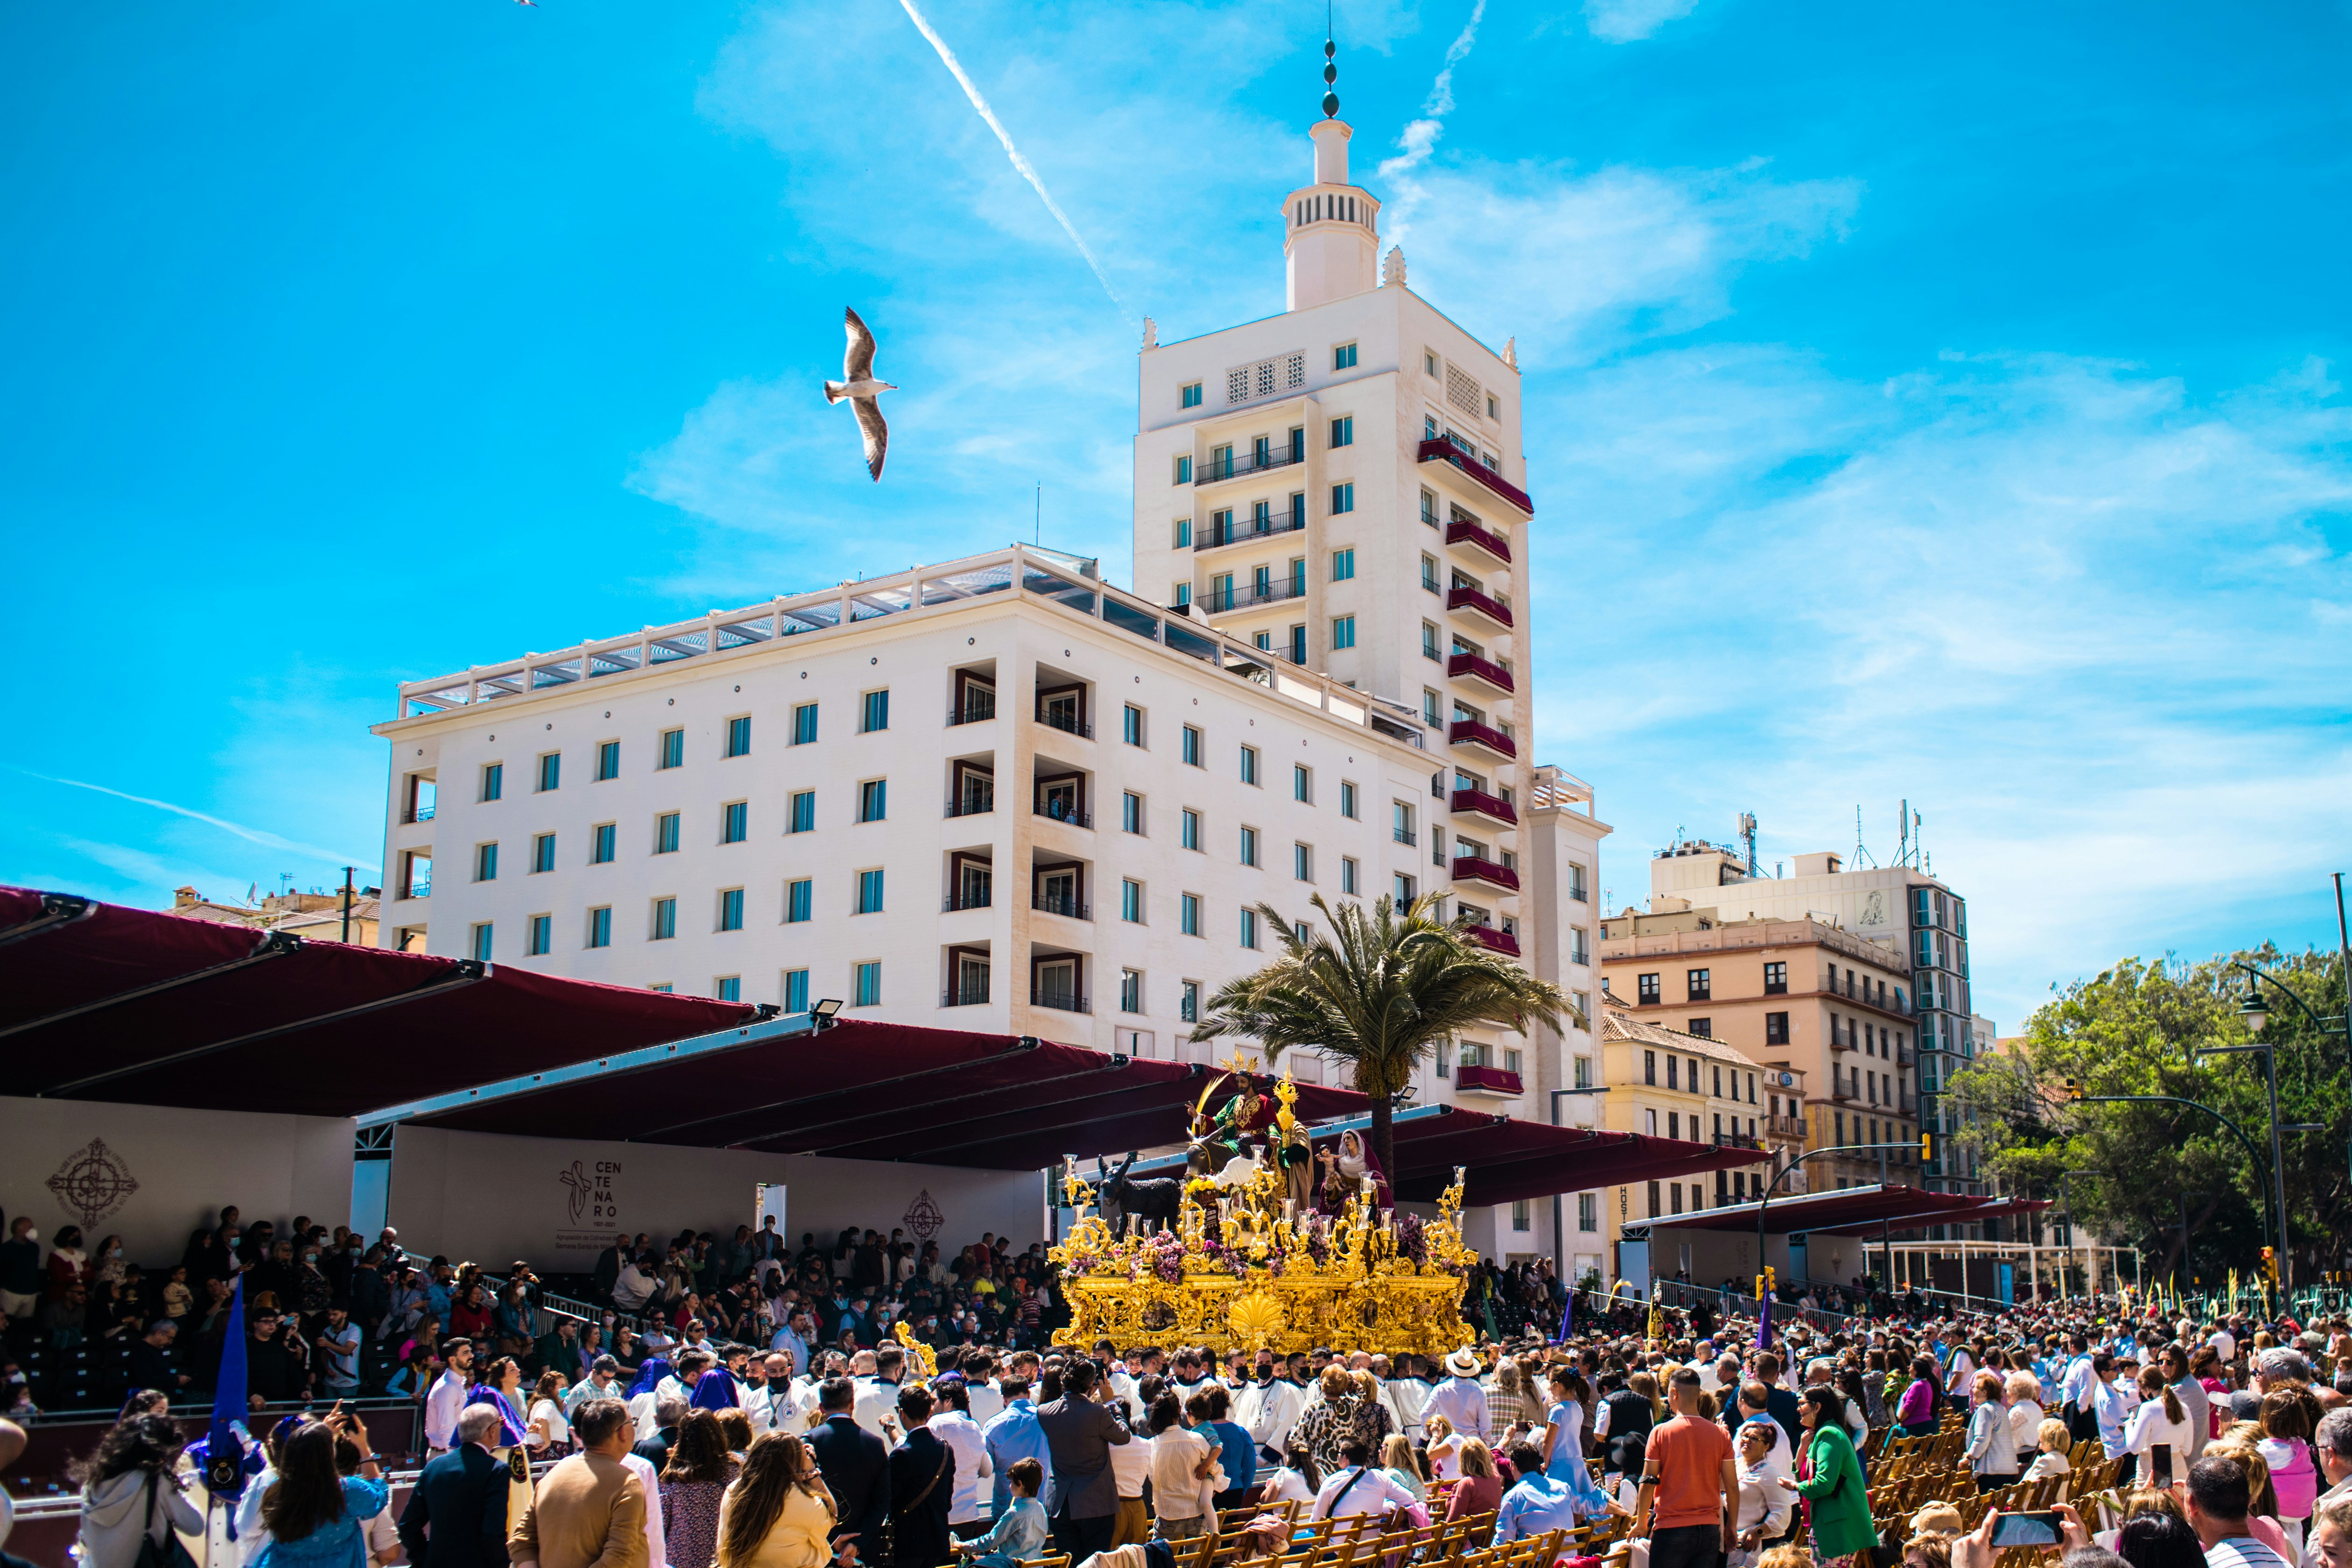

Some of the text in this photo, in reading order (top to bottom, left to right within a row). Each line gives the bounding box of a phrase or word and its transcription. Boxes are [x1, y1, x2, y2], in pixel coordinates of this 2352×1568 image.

[596, 1162, 621, 1173] CEN
[595, 1176, 610, 1187] TE
[595, 1191, 613, 1202] NA
